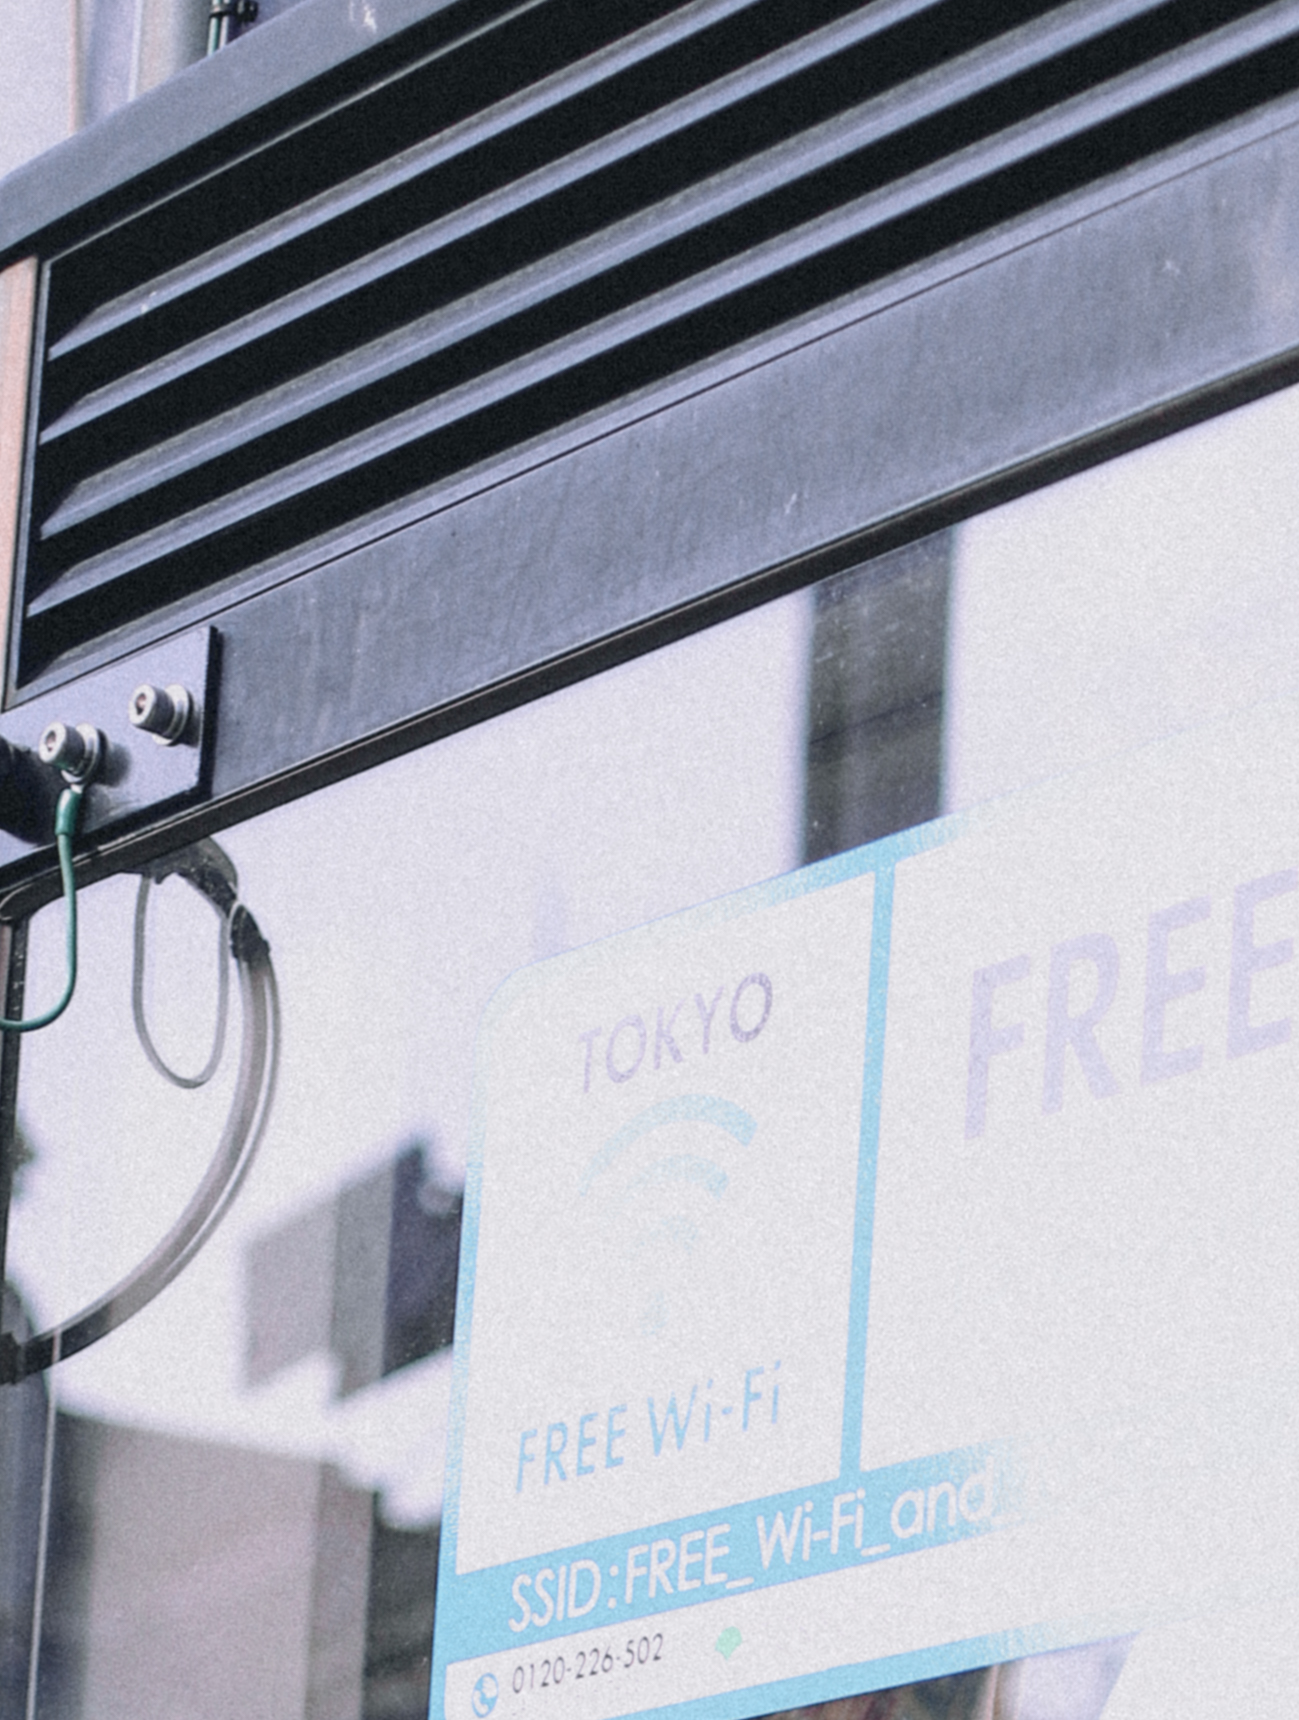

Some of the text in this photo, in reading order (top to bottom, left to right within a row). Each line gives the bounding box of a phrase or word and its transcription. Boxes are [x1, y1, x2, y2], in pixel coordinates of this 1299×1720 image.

[577, 971, 776, 1095] TOKYO
[512, 1378, 783, 1495] FREE Wi-Fi
[511, 1632, 666, 1696] 0120-226-502
